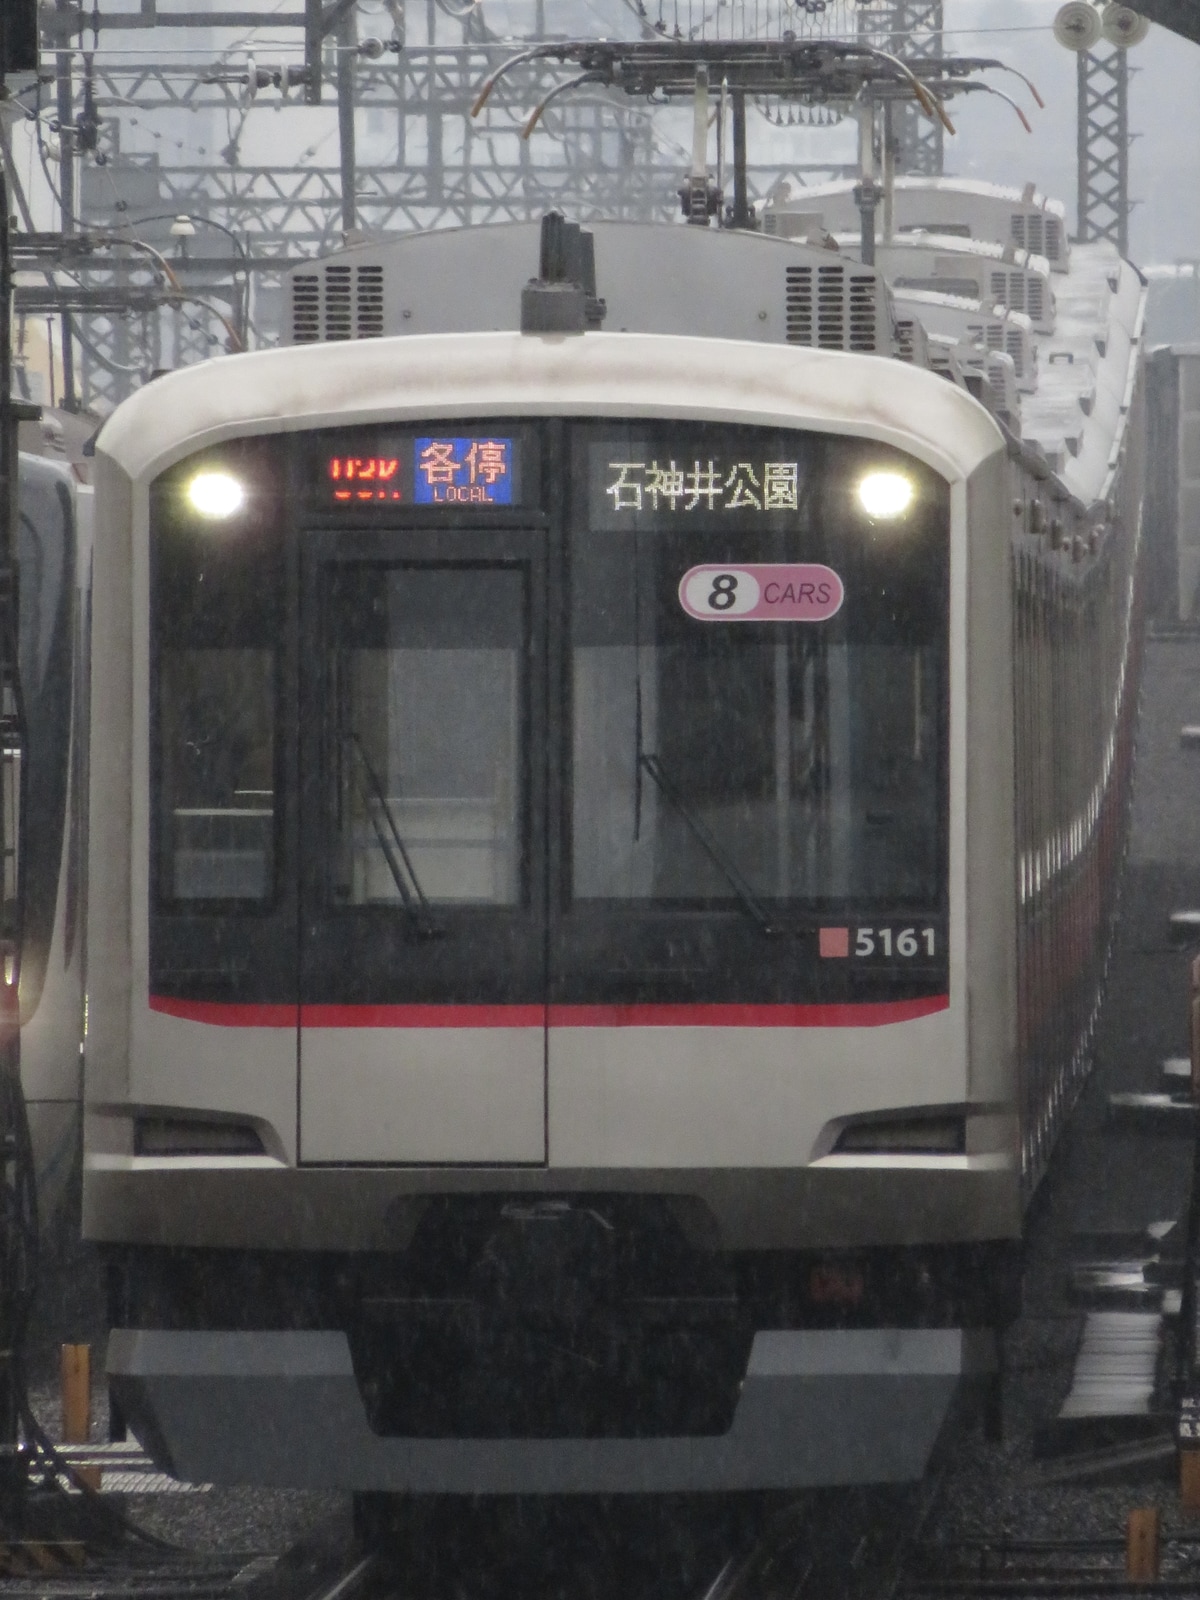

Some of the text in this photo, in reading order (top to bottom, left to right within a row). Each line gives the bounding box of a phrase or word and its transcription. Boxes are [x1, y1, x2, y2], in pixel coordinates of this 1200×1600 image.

[419, 442, 506, 484] 各停
[433, 486, 493, 502] LOCAL
[606, 460, 798, 510] 石神井公園
[708, 574, 831, 610] 8 CARS
[855, 928, 935, 956] 5161
